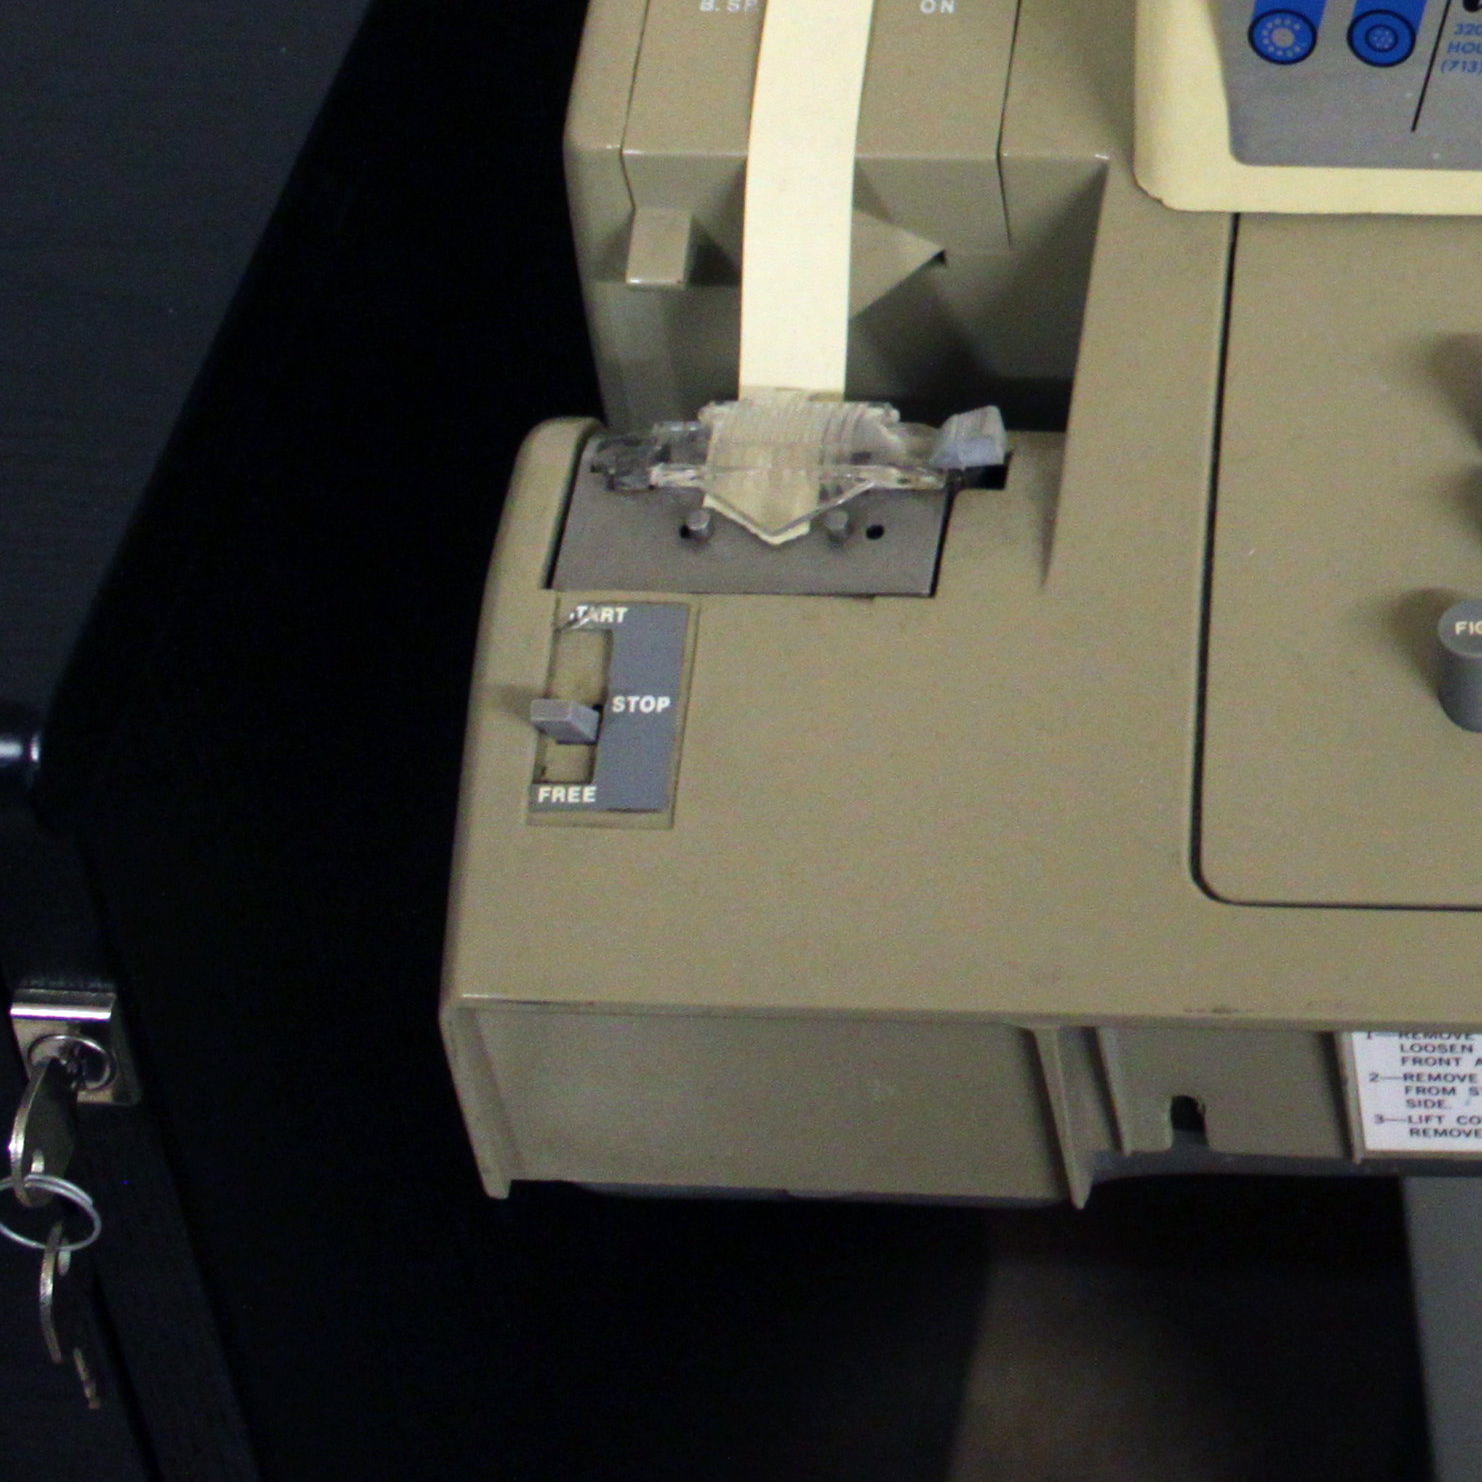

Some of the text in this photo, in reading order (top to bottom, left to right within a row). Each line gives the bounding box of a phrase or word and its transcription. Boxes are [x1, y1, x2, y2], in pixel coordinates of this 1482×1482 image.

[612, 696, 670, 712] STOP
[538, 787, 597, 802] FREE
[1400, 1044, 1473, 1054] LOOSEN
[1401, 1057, 1462, 1067] FRONT
[1405, 1086, 1456, 1096] FROM
